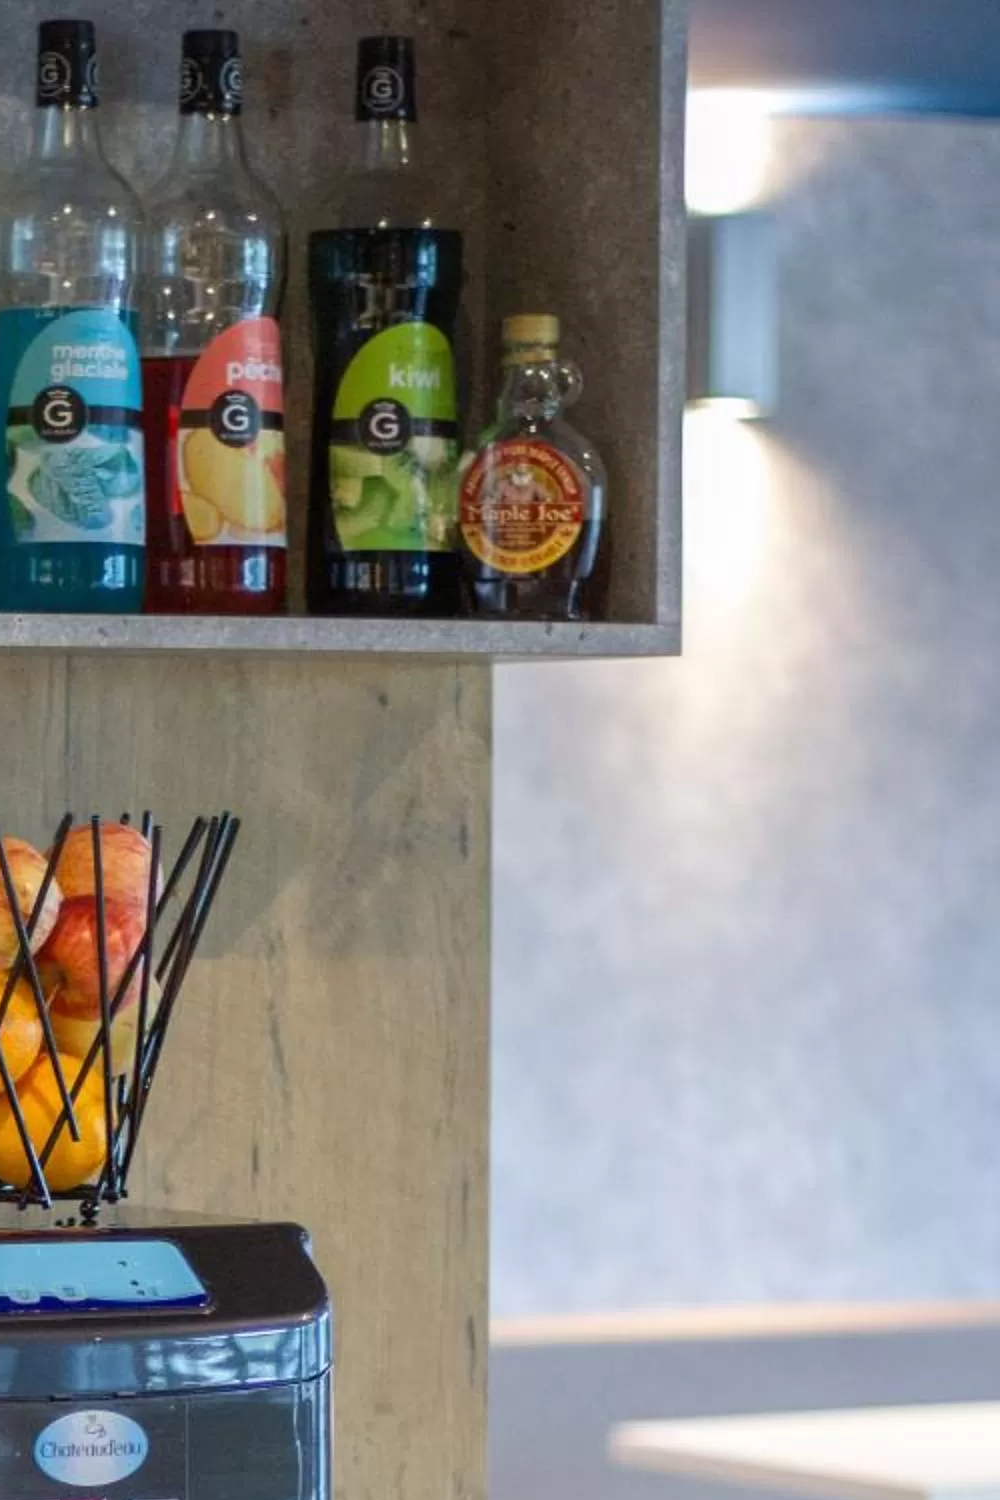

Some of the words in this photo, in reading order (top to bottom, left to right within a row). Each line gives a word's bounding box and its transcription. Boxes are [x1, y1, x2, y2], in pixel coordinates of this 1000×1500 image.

[52, 343, 126, 361] menthe
[51, 360, 128, 383] glaciale
[227, 356, 282, 386] pêch
[389, 363, 441, 389] kiwi
[43, 400, 73, 427] G
[222, 404, 250, 431] G
[370, 412, 400, 440] G
